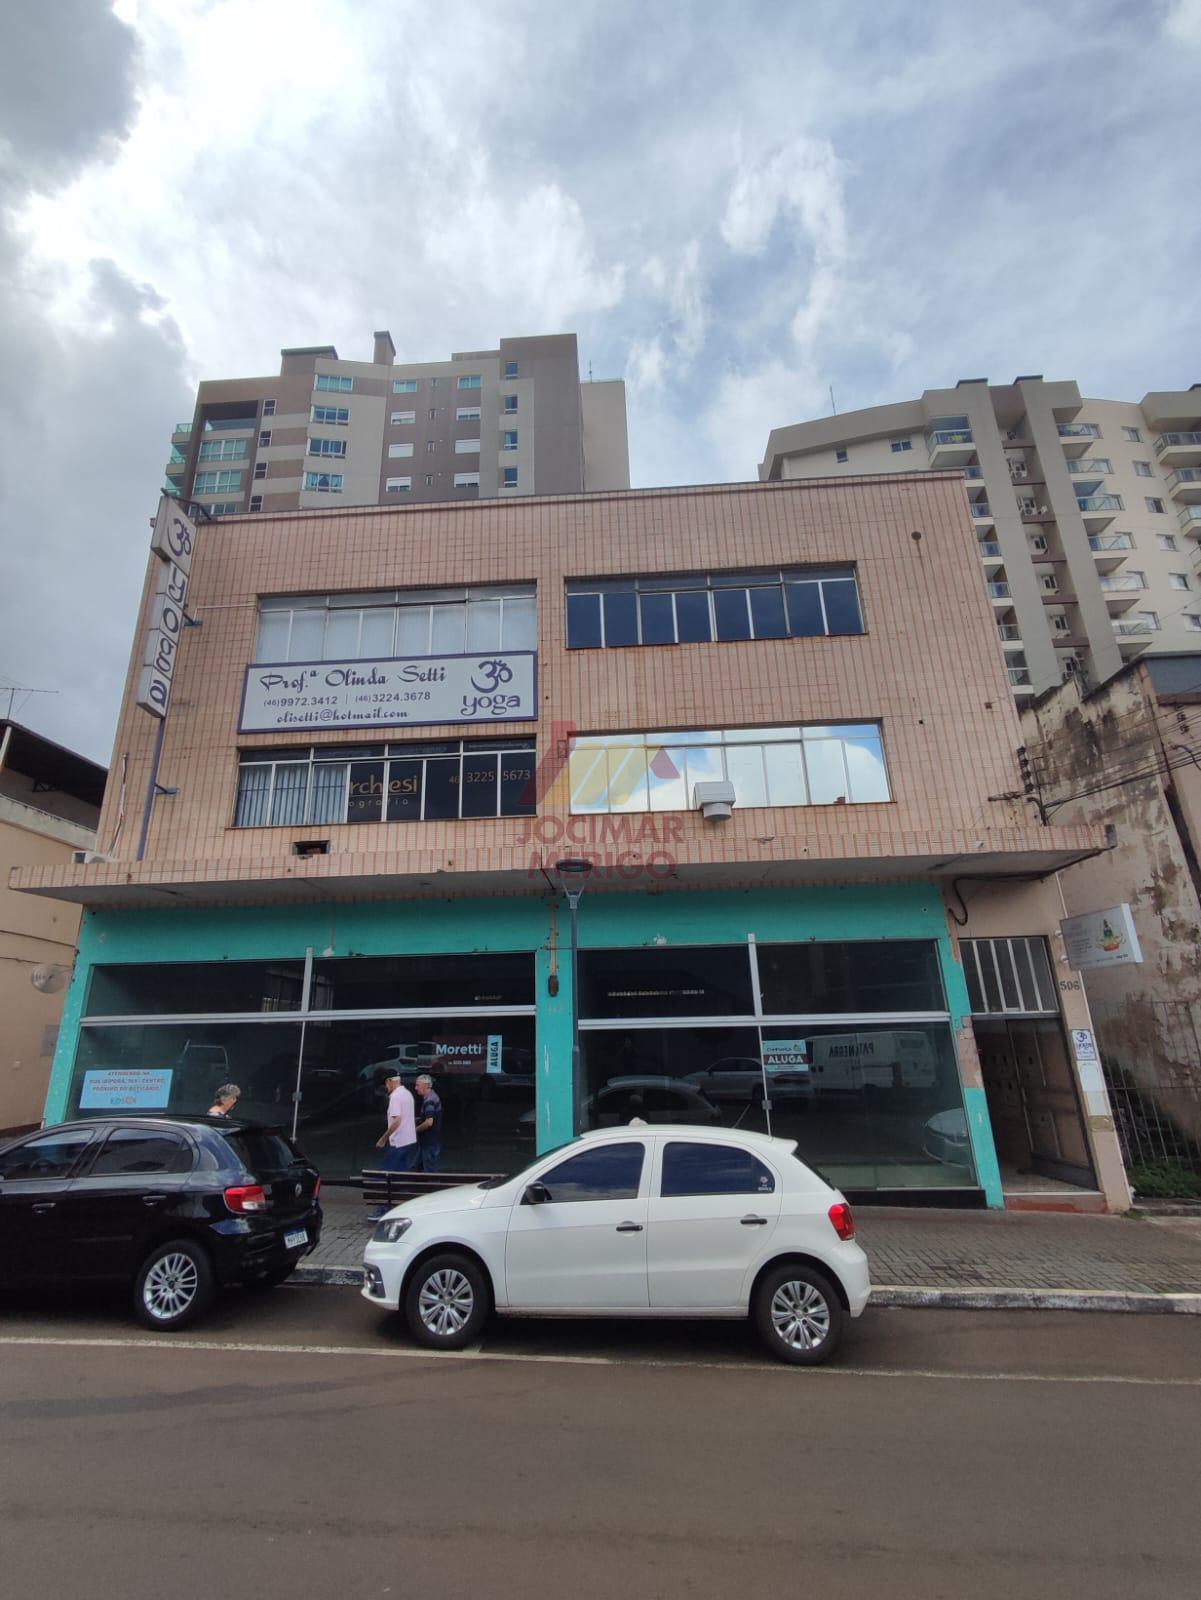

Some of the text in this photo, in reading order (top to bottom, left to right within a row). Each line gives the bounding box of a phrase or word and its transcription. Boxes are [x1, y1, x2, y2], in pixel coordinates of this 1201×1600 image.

[149, 566, 187, 708] yoga
[325, 668, 388, 688] Olinda
[397, 665, 447, 683] Setti
[460, 694, 521, 716] yoga
[276, 708, 409, 724] olisetti@hotmail.com
[466, 771, 495, 783] 3225
[503, 769, 531, 782] 5673
[1060, 981, 1080, 991] 506
[435, 1043, 482, 1055] Moretti
[490, 1041, 499, 1067] ALUGA
[767, 1055, 804, 1064] ALUGA
